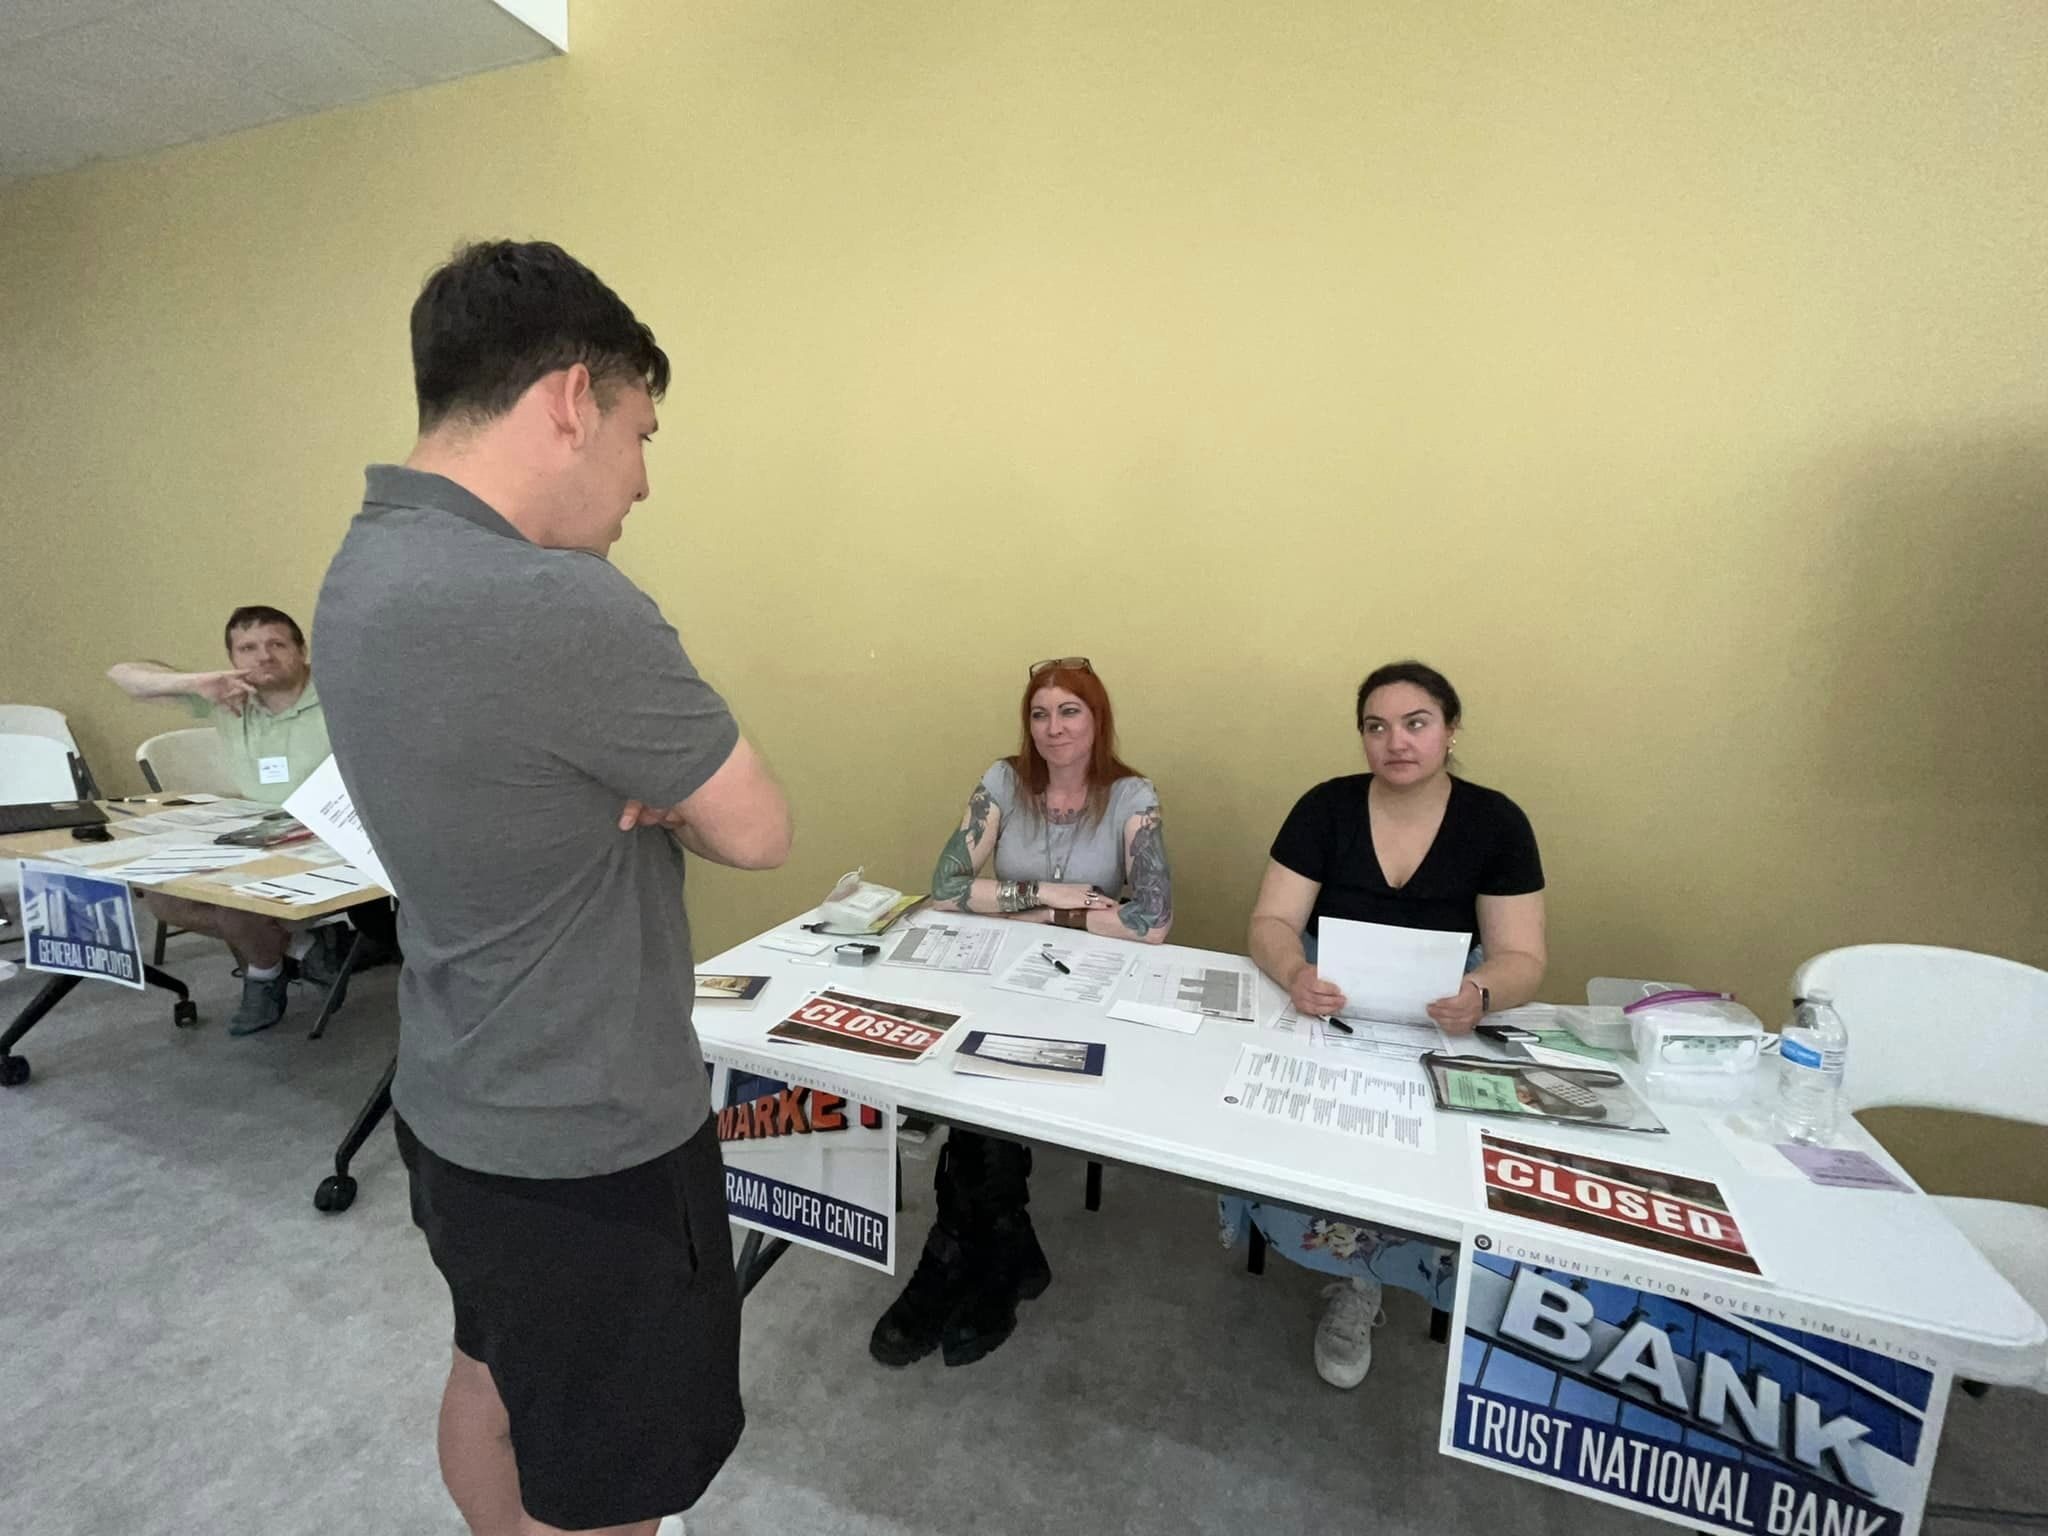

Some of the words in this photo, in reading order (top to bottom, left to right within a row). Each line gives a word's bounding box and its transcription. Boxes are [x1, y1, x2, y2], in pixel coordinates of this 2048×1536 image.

[39, 939, 85, 969] GENERAL
[85, 945, 134, 979] EMPLOYER
[801, 1004, 930, 1046] CLOSED
[772, 1186, 821, 1230] SUPER
[825, 1202, 883, 1251] CENTER
[1497, 1158, 1723, 1241] CLOSED
[1506, 1245, 1612, 1278] COMMUNITY
[1623, 1273, 1690, 1297] ACTION
[1703, 1292, 1787, 1319] POVERTY
[1800, 1316, 1937, 1367] SIMULATION
[1499, 1267, 1877, 1497] BANK
[1466, 1394, 1572, 1471] TRUST
[1578, 1426, 1754, 1527] NATIONAL
